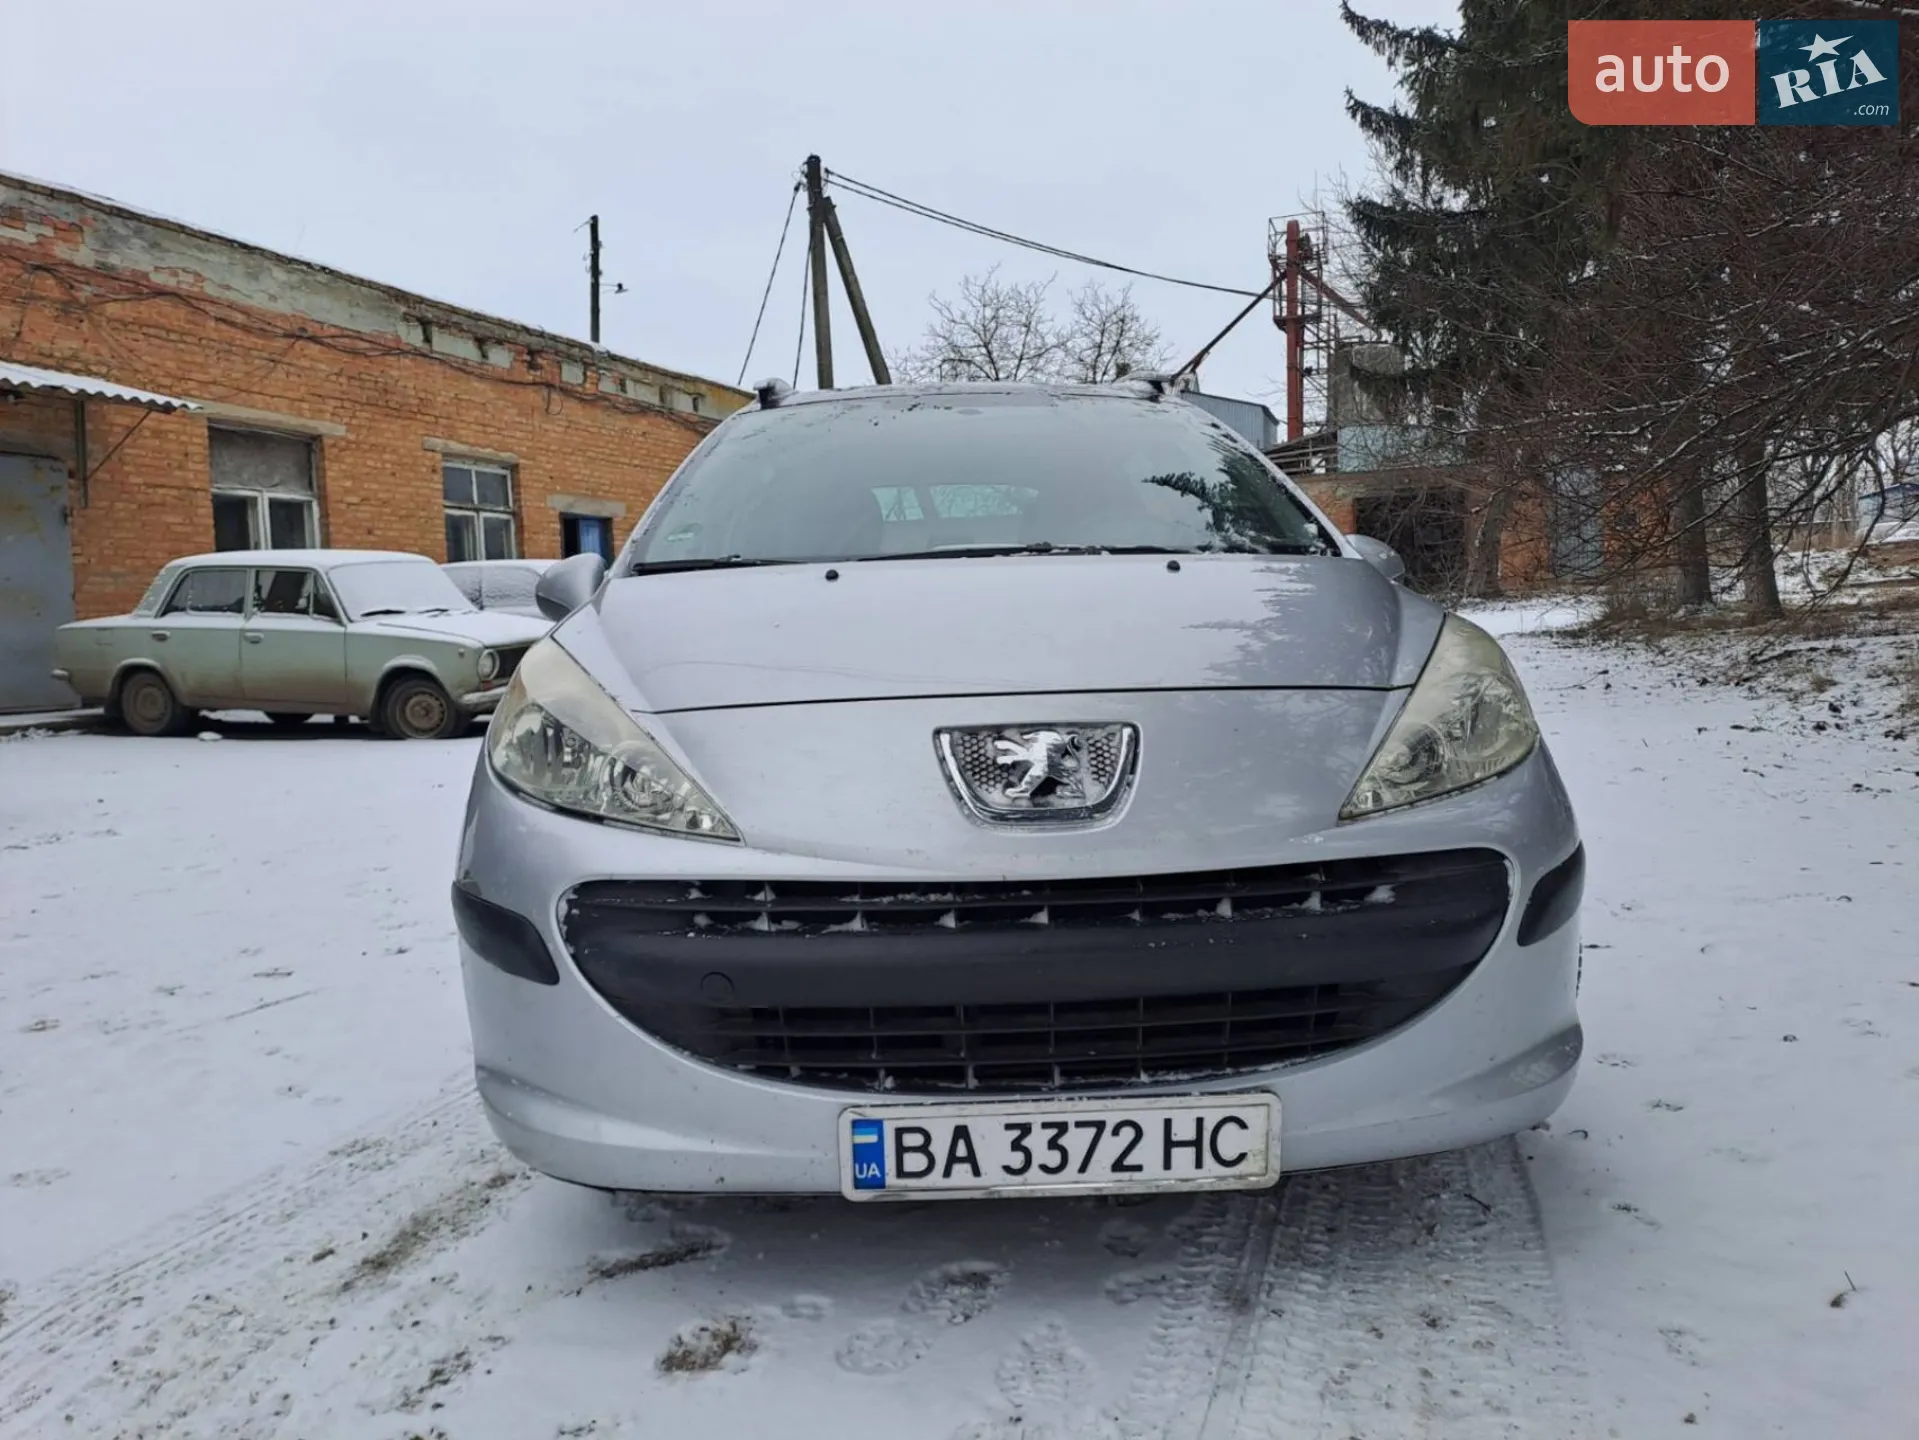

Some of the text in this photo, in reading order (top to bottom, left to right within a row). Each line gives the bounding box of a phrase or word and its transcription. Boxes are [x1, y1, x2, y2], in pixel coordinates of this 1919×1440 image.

[894, 1115, 1250, 1180] BA 3372 HC
[854, 1162, 882, 1180] UA
